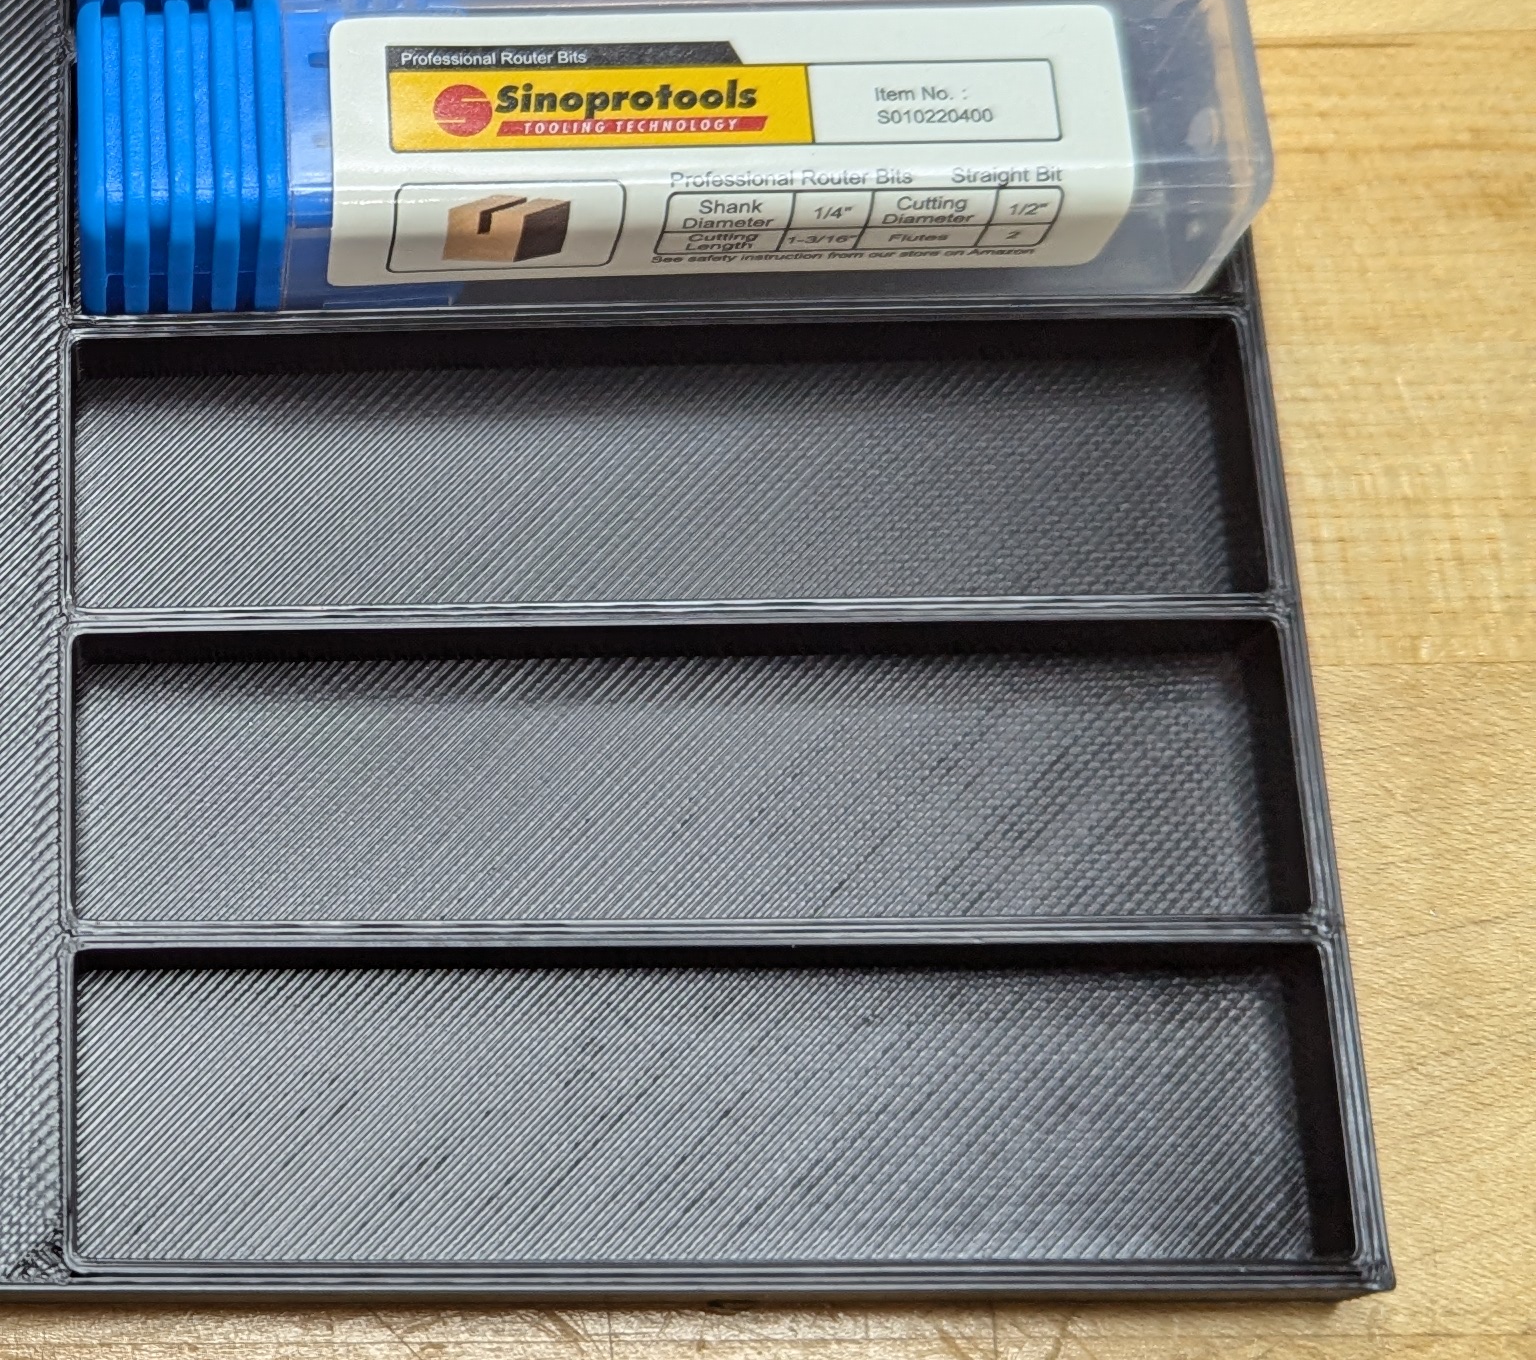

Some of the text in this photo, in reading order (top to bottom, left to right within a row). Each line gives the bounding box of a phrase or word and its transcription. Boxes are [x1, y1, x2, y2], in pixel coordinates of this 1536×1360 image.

[400, 50, 588, 66] Professional Router Bits
[494, 79, 758, 120] Sinoprotools
[875, 87, 915, 101] Item
[921, 86, 954, 101] No.
[877, 108, 994, 124] S010220400
[523, 118, 739, 136] TOOLING TECHNOLOGY
[670, 168, 913, 188] Professional Router Bits
[951, 166, 1064, 187] Straight Bit
[698, 199, 763, 214] Shank
[896, 196, 968, 211] Cutting
[1009, 202, 1050, 216] 1/2"
[814, 205, 853, 220] 1/4"
[881, 213, 974, 225] Diameter
[682, 217, 774, 230] Diameter
[688, 233, 759, 243] Cutting
[888, 233, 949, 242] Flutes
[1005, 231, 1021, 240] 2
[685, 242, 753, 252] Length
[652, 255, 683, 264] See
[688, 254, 737, 263] safety
[740, 253, 822, 261] instruction
[868, 251, 897, 259] our
[899, 249, 942, 258] store
[967, 248, 1034, 257] Amazon
